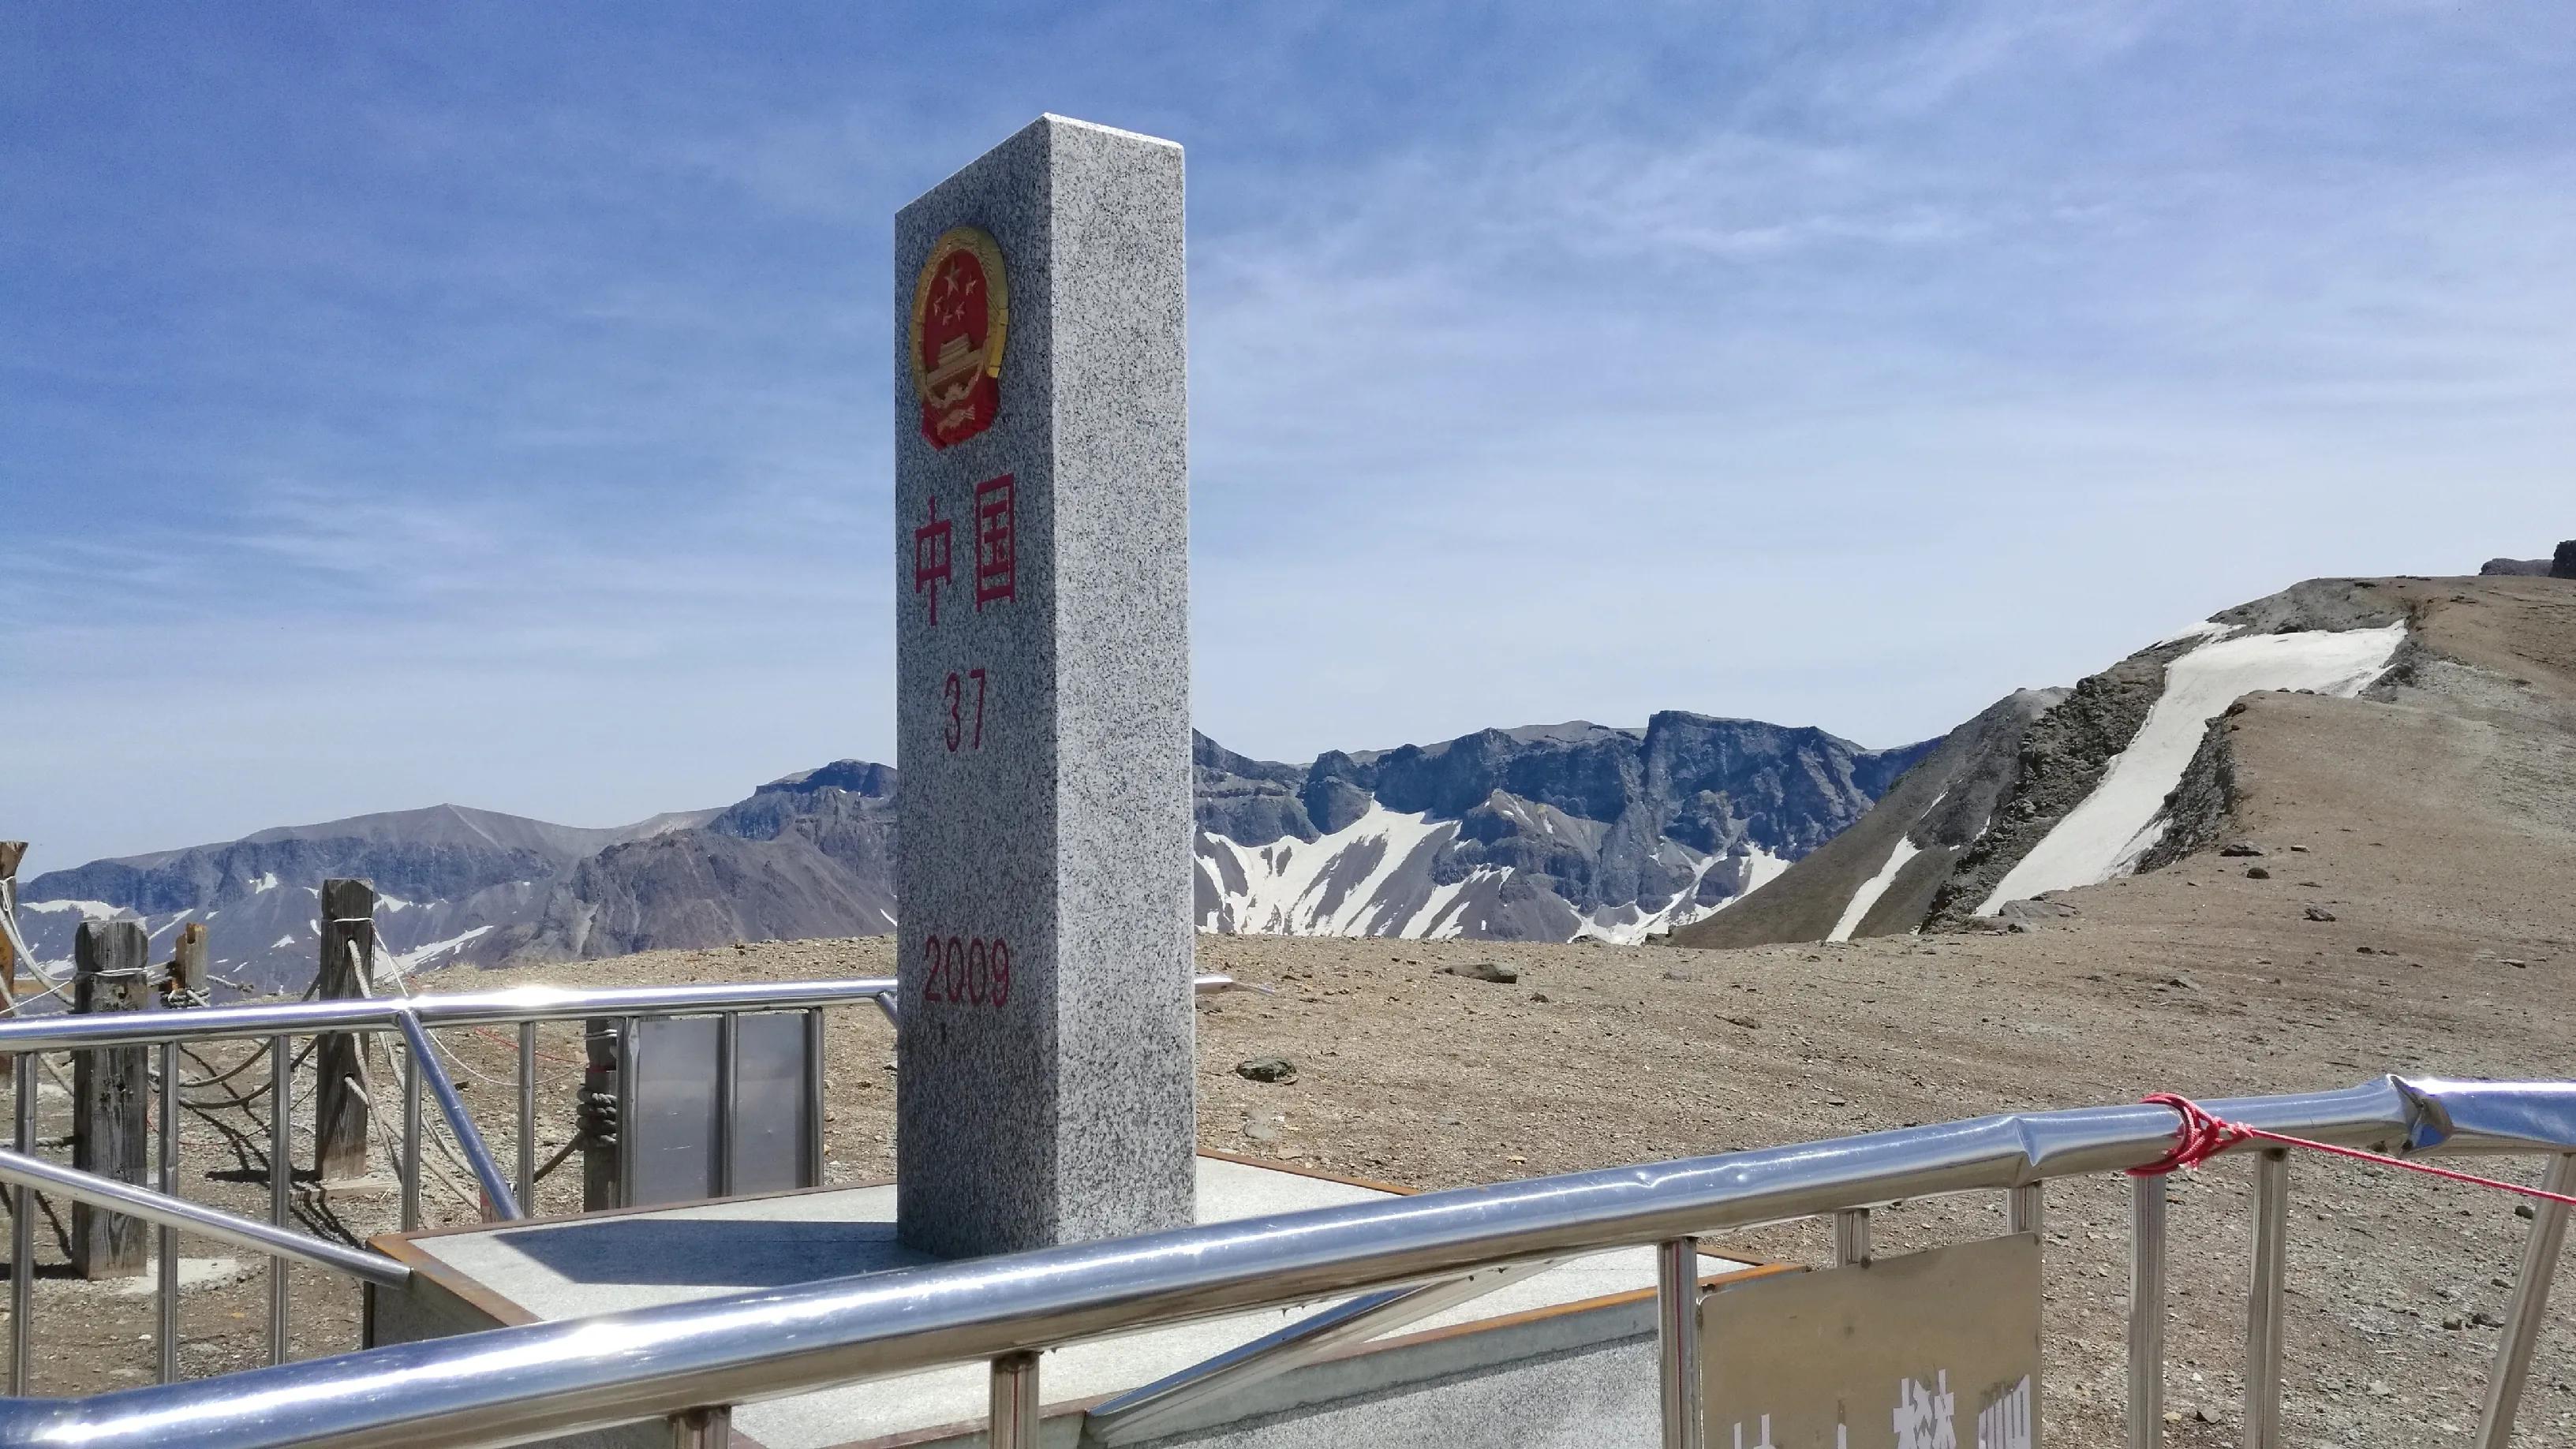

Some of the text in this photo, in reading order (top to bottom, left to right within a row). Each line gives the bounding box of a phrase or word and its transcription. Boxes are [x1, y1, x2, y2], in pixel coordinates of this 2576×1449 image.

[914, 473, 1015, 626] 中国
[945, 668, 985, 752] 37
[924, 934, 1010, 1007] 2009
